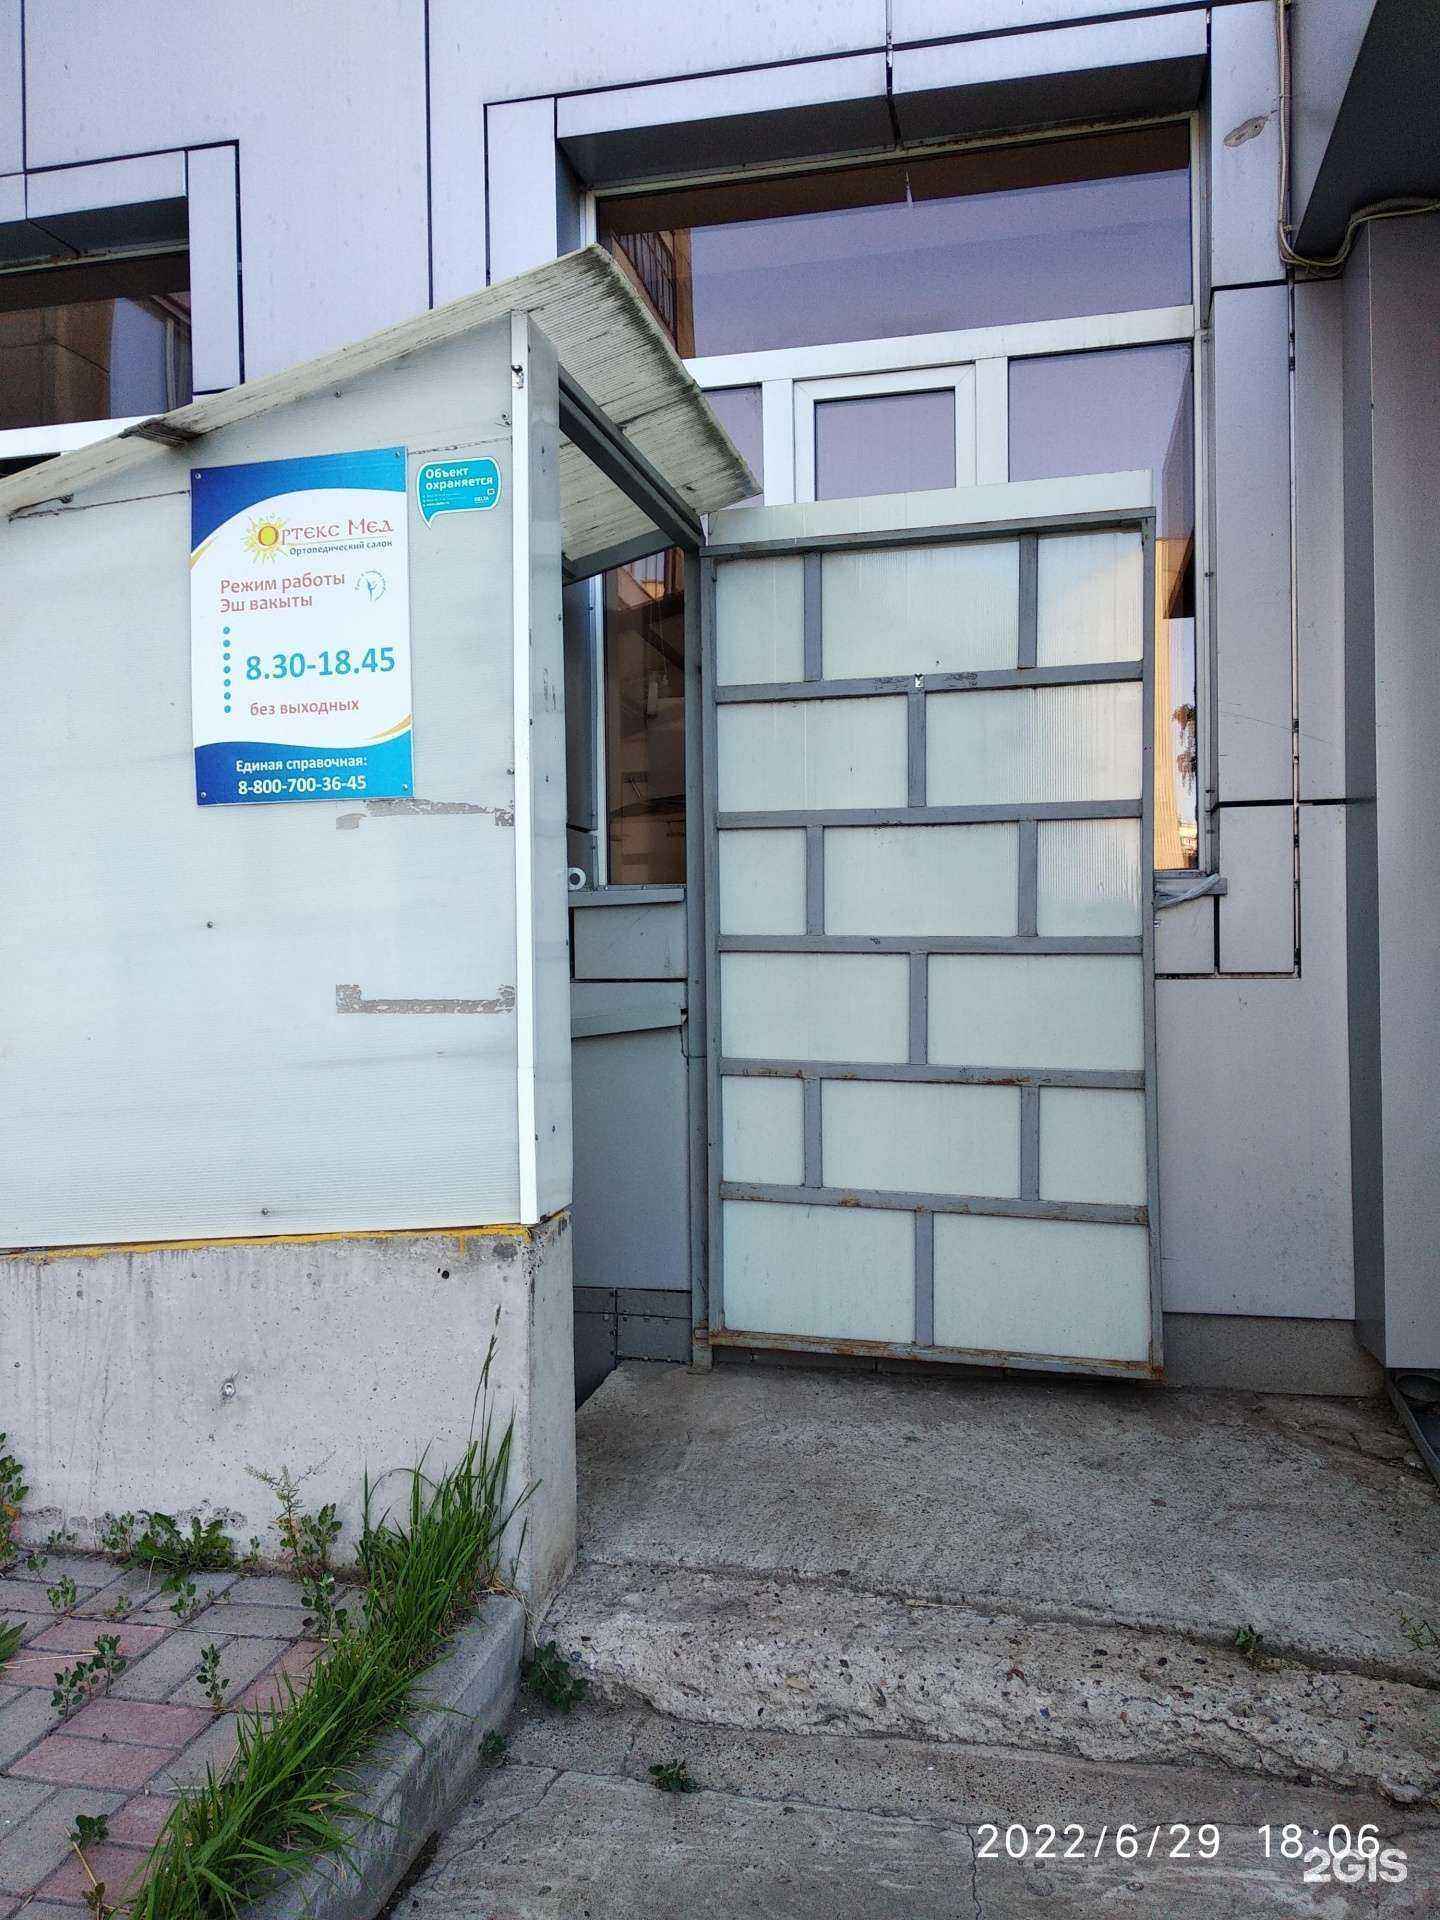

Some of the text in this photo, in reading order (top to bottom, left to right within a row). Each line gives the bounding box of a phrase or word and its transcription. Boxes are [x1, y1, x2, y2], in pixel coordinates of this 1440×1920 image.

[425, 468, 469, 479] Объект
[425, 477, 493, 491] охраняется
[289, 540, 393, 556] Ортопедический салон
[220, 576, 277, 594] Режим
[282, 572, 345, 593] работы
[220, 595, 313, 613] Эш вакыты
[246, 646, 396, 681] 8.30-18.45
[250, 699, 360, 716] без выходных
[236, 756, 367, 774] Единая справочная:
[238, 775, 367, 795] 8-800-700-36-45
